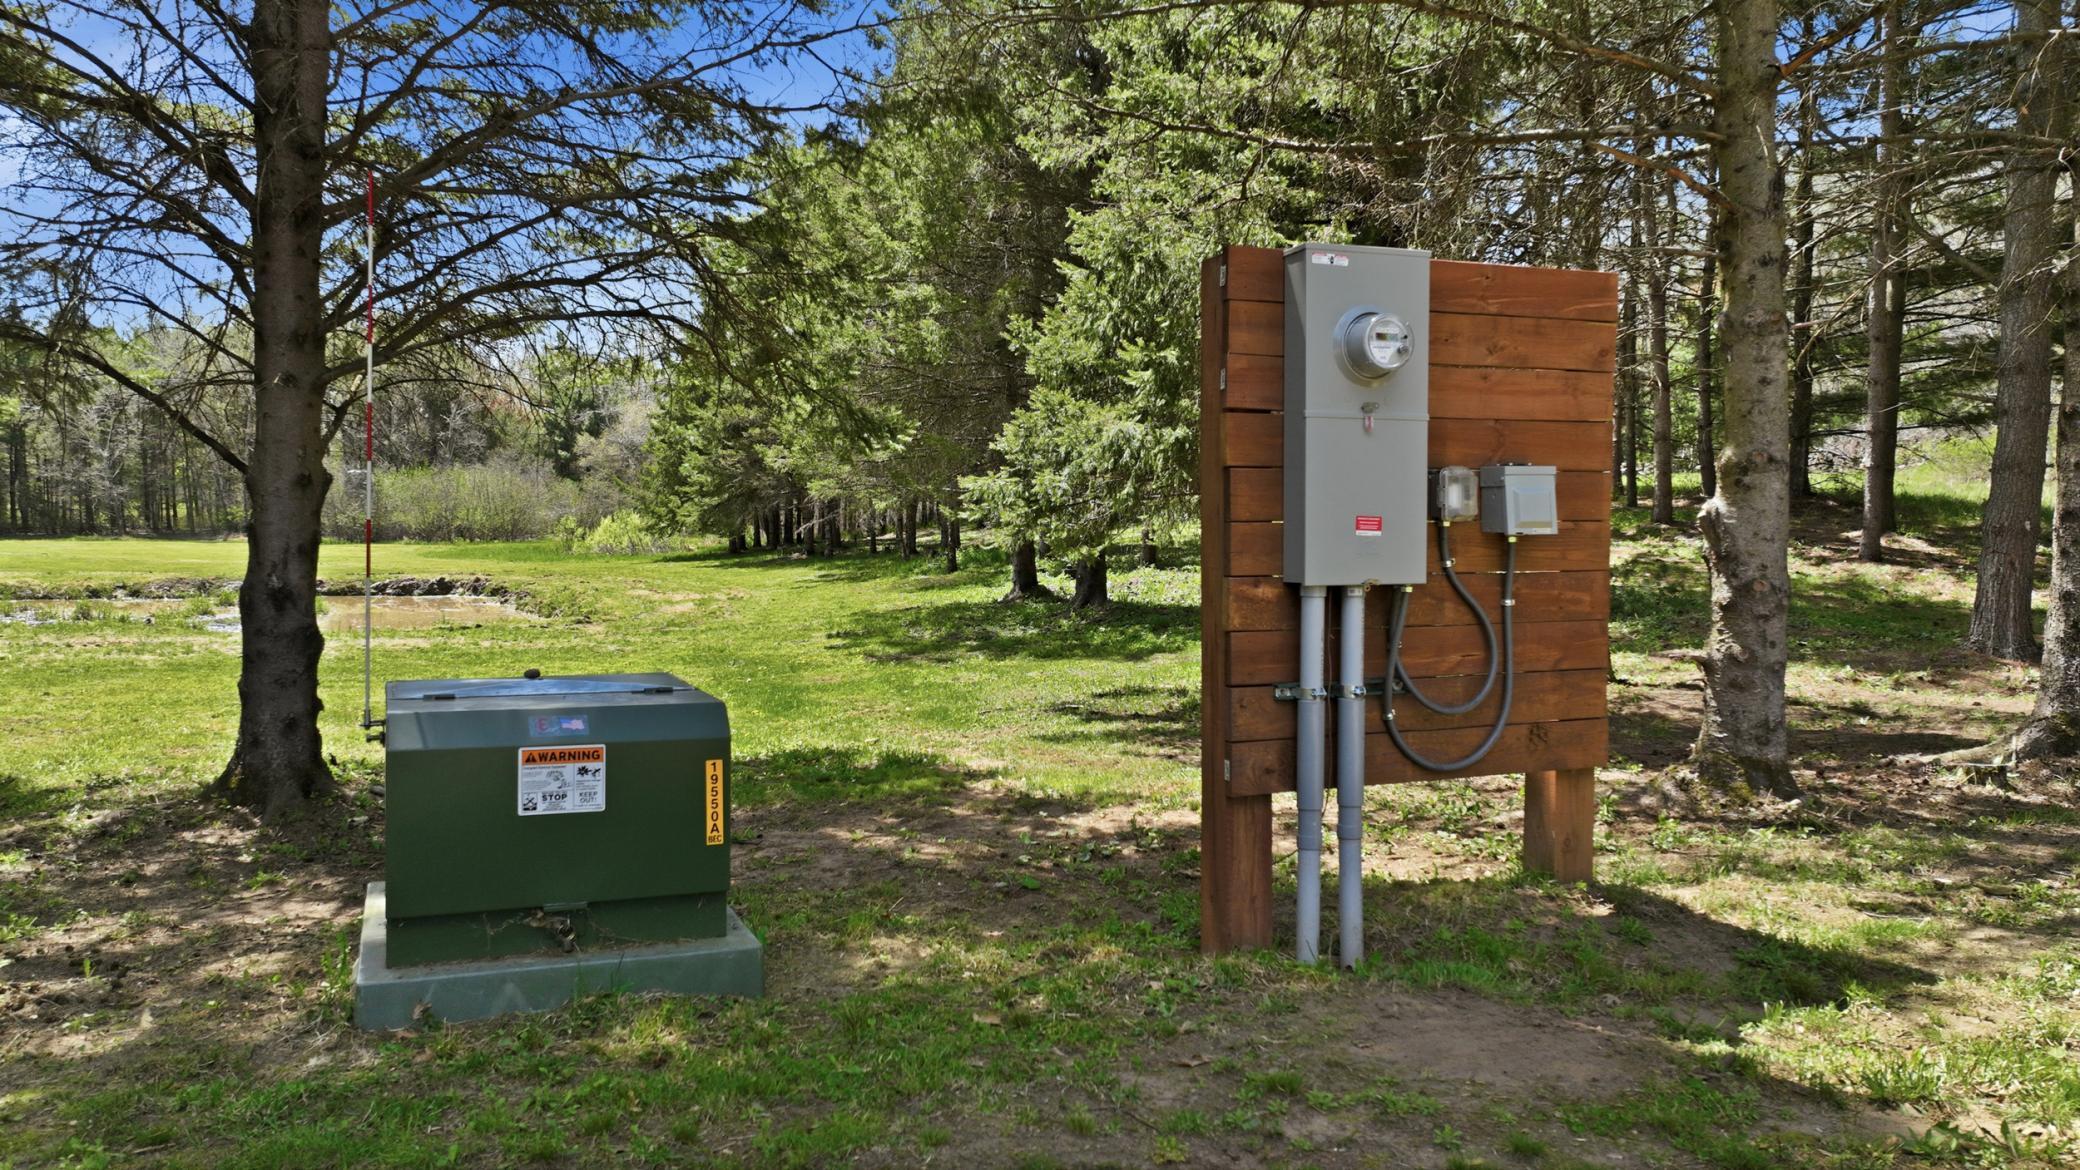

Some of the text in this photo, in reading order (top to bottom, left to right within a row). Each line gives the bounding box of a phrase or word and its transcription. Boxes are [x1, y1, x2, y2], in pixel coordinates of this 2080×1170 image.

[538, 750, 600, 762] WARNING
[542, 793, 568, 802] STOP
[710, 762, 720, 834] 19550A
